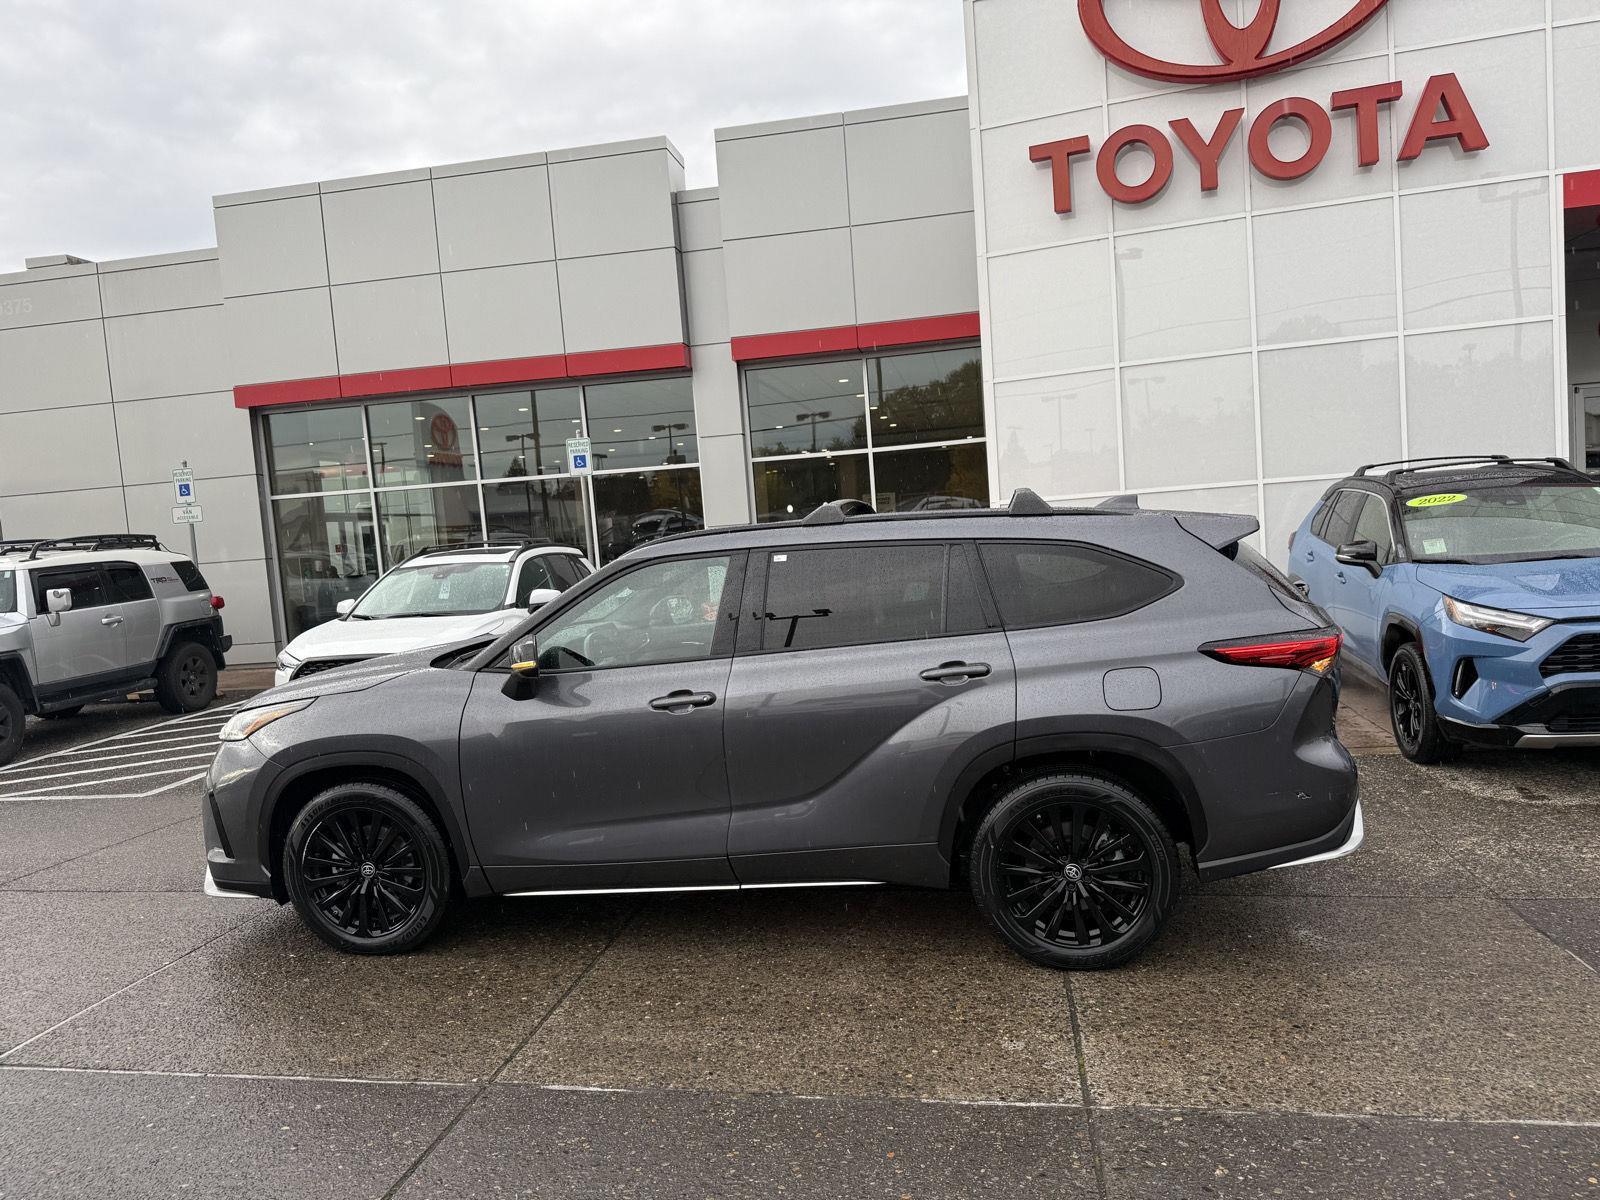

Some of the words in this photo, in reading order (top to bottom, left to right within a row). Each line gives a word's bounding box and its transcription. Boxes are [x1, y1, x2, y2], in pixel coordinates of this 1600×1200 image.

[1029, 73, 1490, 215] TOYOTA
[0, 297, 33, 316] 375
[1417, 495, 1456, 506] 2022
